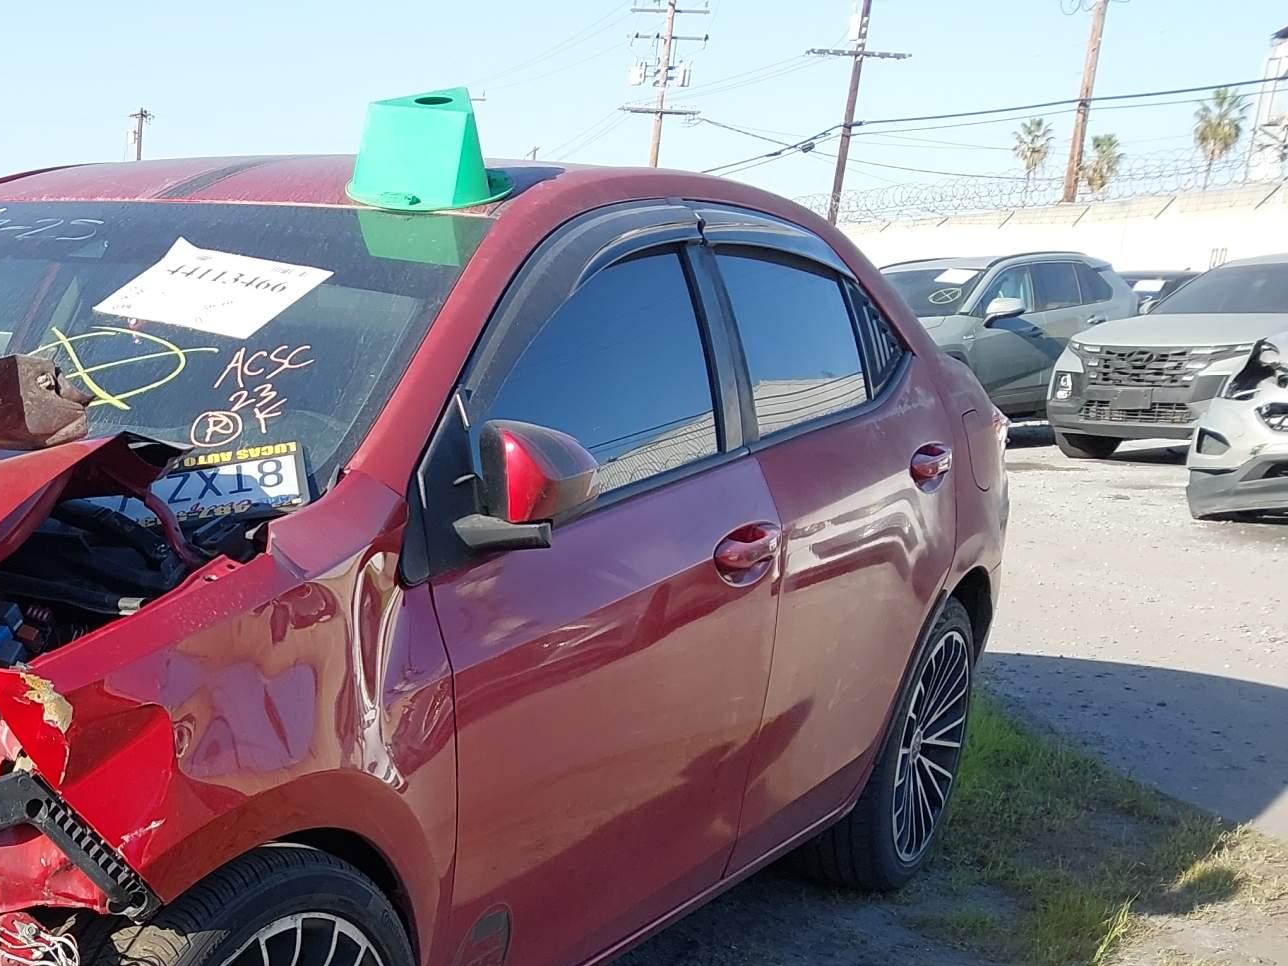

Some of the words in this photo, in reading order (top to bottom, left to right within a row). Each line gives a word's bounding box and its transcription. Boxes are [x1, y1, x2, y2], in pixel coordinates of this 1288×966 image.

[167, 264, 287, 293] 44113466
[213, 346, 314, 389] ACSC
[236, 441, 297, 461] LUCAS
